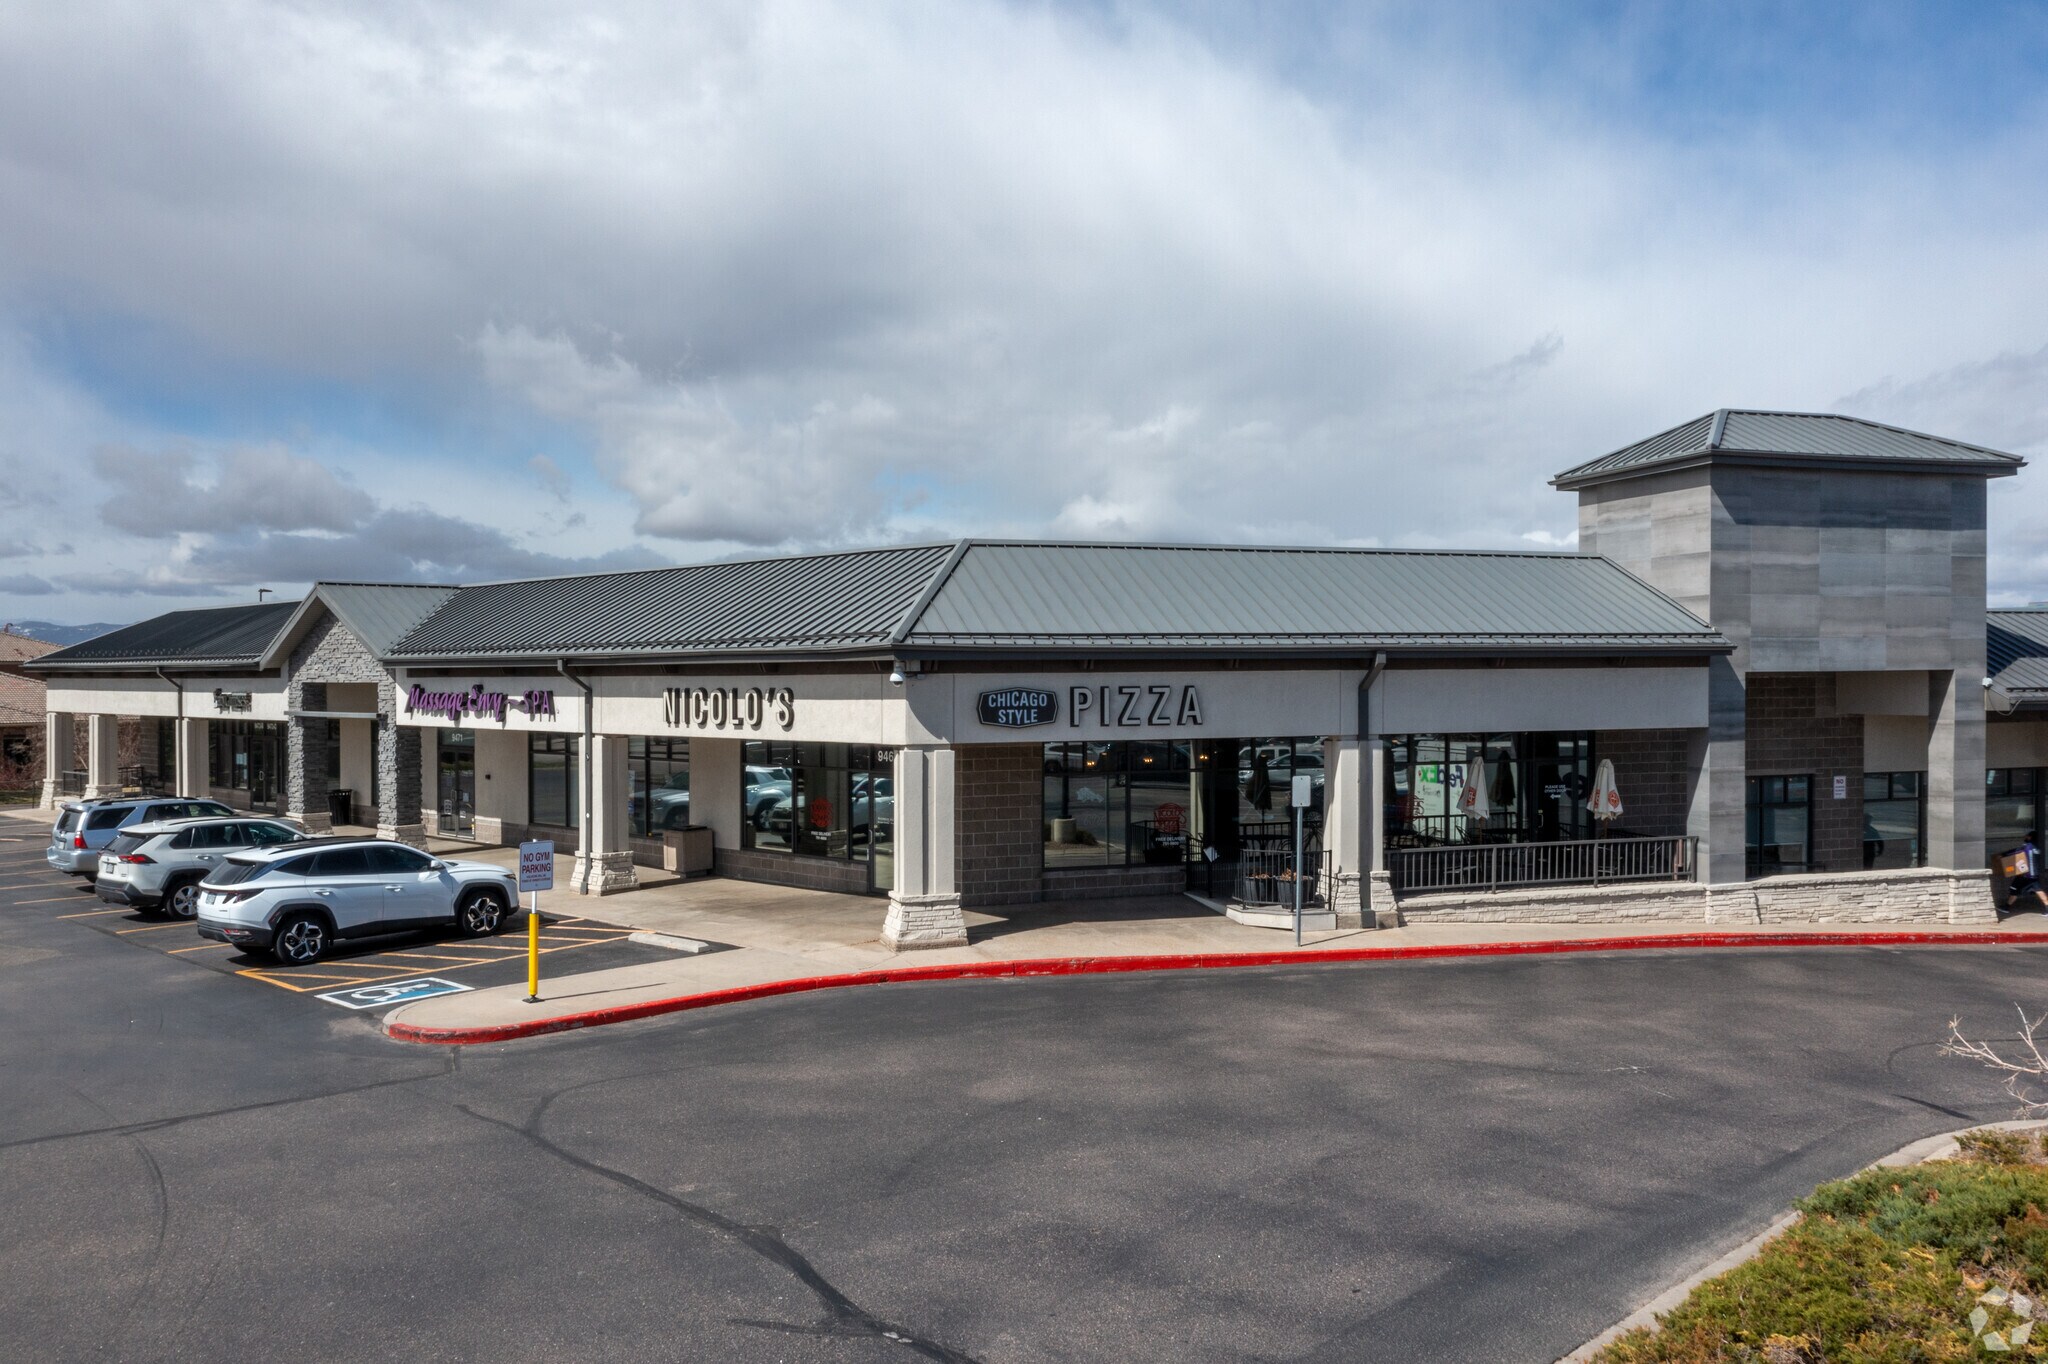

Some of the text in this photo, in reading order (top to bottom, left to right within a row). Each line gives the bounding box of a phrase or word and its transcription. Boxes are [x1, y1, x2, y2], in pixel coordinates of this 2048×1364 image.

[408, 684, 552, 722] Massage Envy SPA
[662, 687, 795, 728] NICOLO'S
[987, 691, 1048, 708] CHICAGO
[1069, 685, 1203, 728] PIZZA
[998, 709, 1038, 725] STYLE
[523, 851, 550, 862] NO GYM
[522, 863, 551, 874] PARKING
